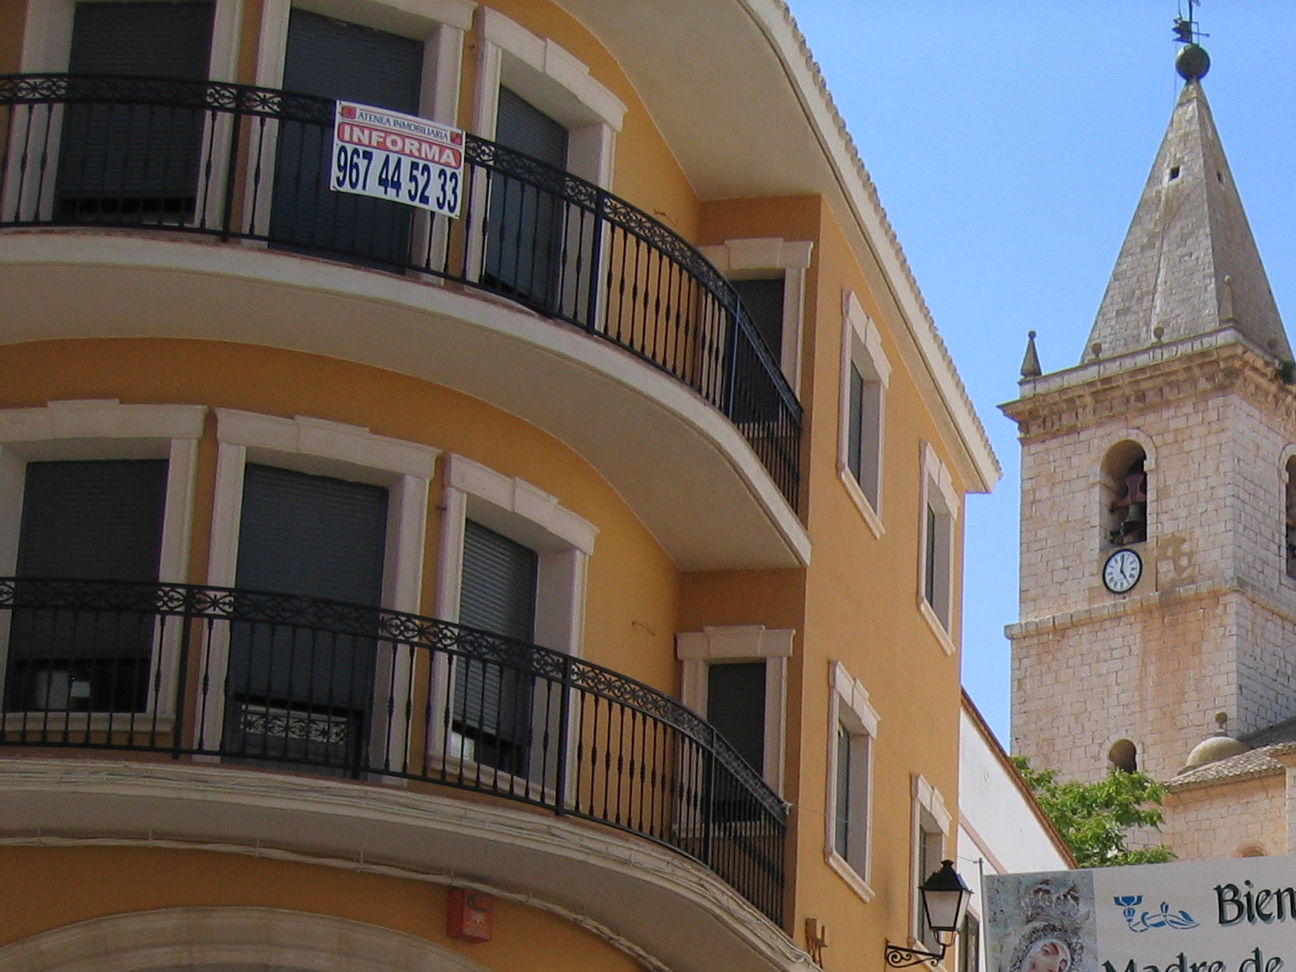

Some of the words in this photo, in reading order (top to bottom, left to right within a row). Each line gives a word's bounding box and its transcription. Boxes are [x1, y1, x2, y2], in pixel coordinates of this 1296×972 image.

[344, 125, 456, 165] INFORMA
[358, 112, 391, 125] ATENEA
[393, 118, 448, 141] INMOBILIARIA
[336, 146, 373, 190] 967
[378, 155, 401, 197] 44
[408, 161, 430, 205] 52
[436, 169, 458, 213] 33
